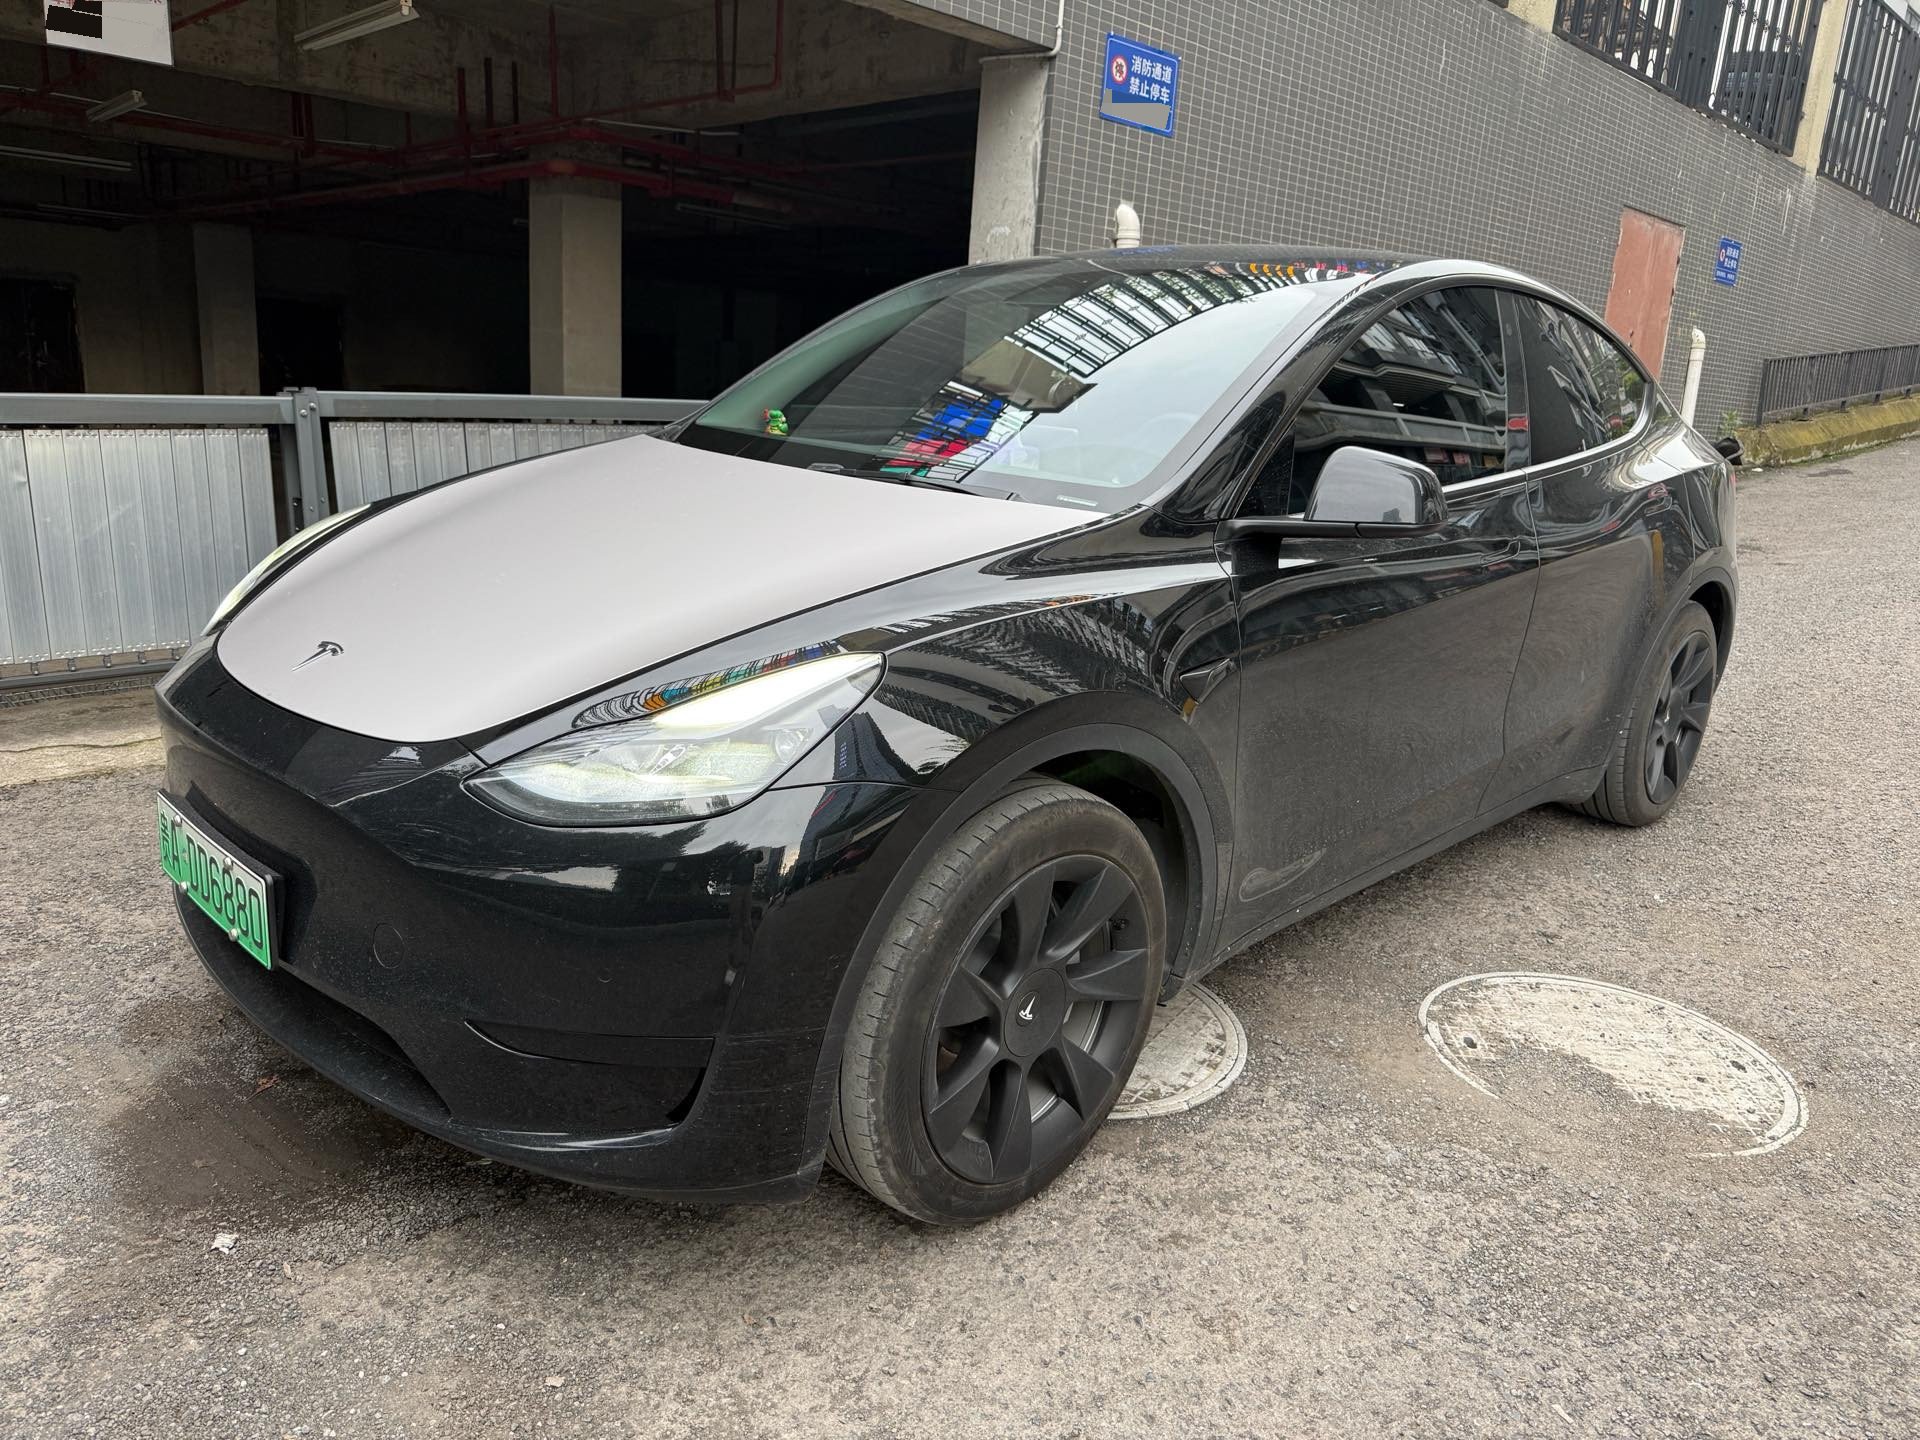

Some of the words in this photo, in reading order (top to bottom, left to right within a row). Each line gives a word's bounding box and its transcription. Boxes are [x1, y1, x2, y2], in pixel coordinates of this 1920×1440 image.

[1131, 55, 1172, 83] 消防通道
[1129, 77, 1170, 103] 禁止停车
